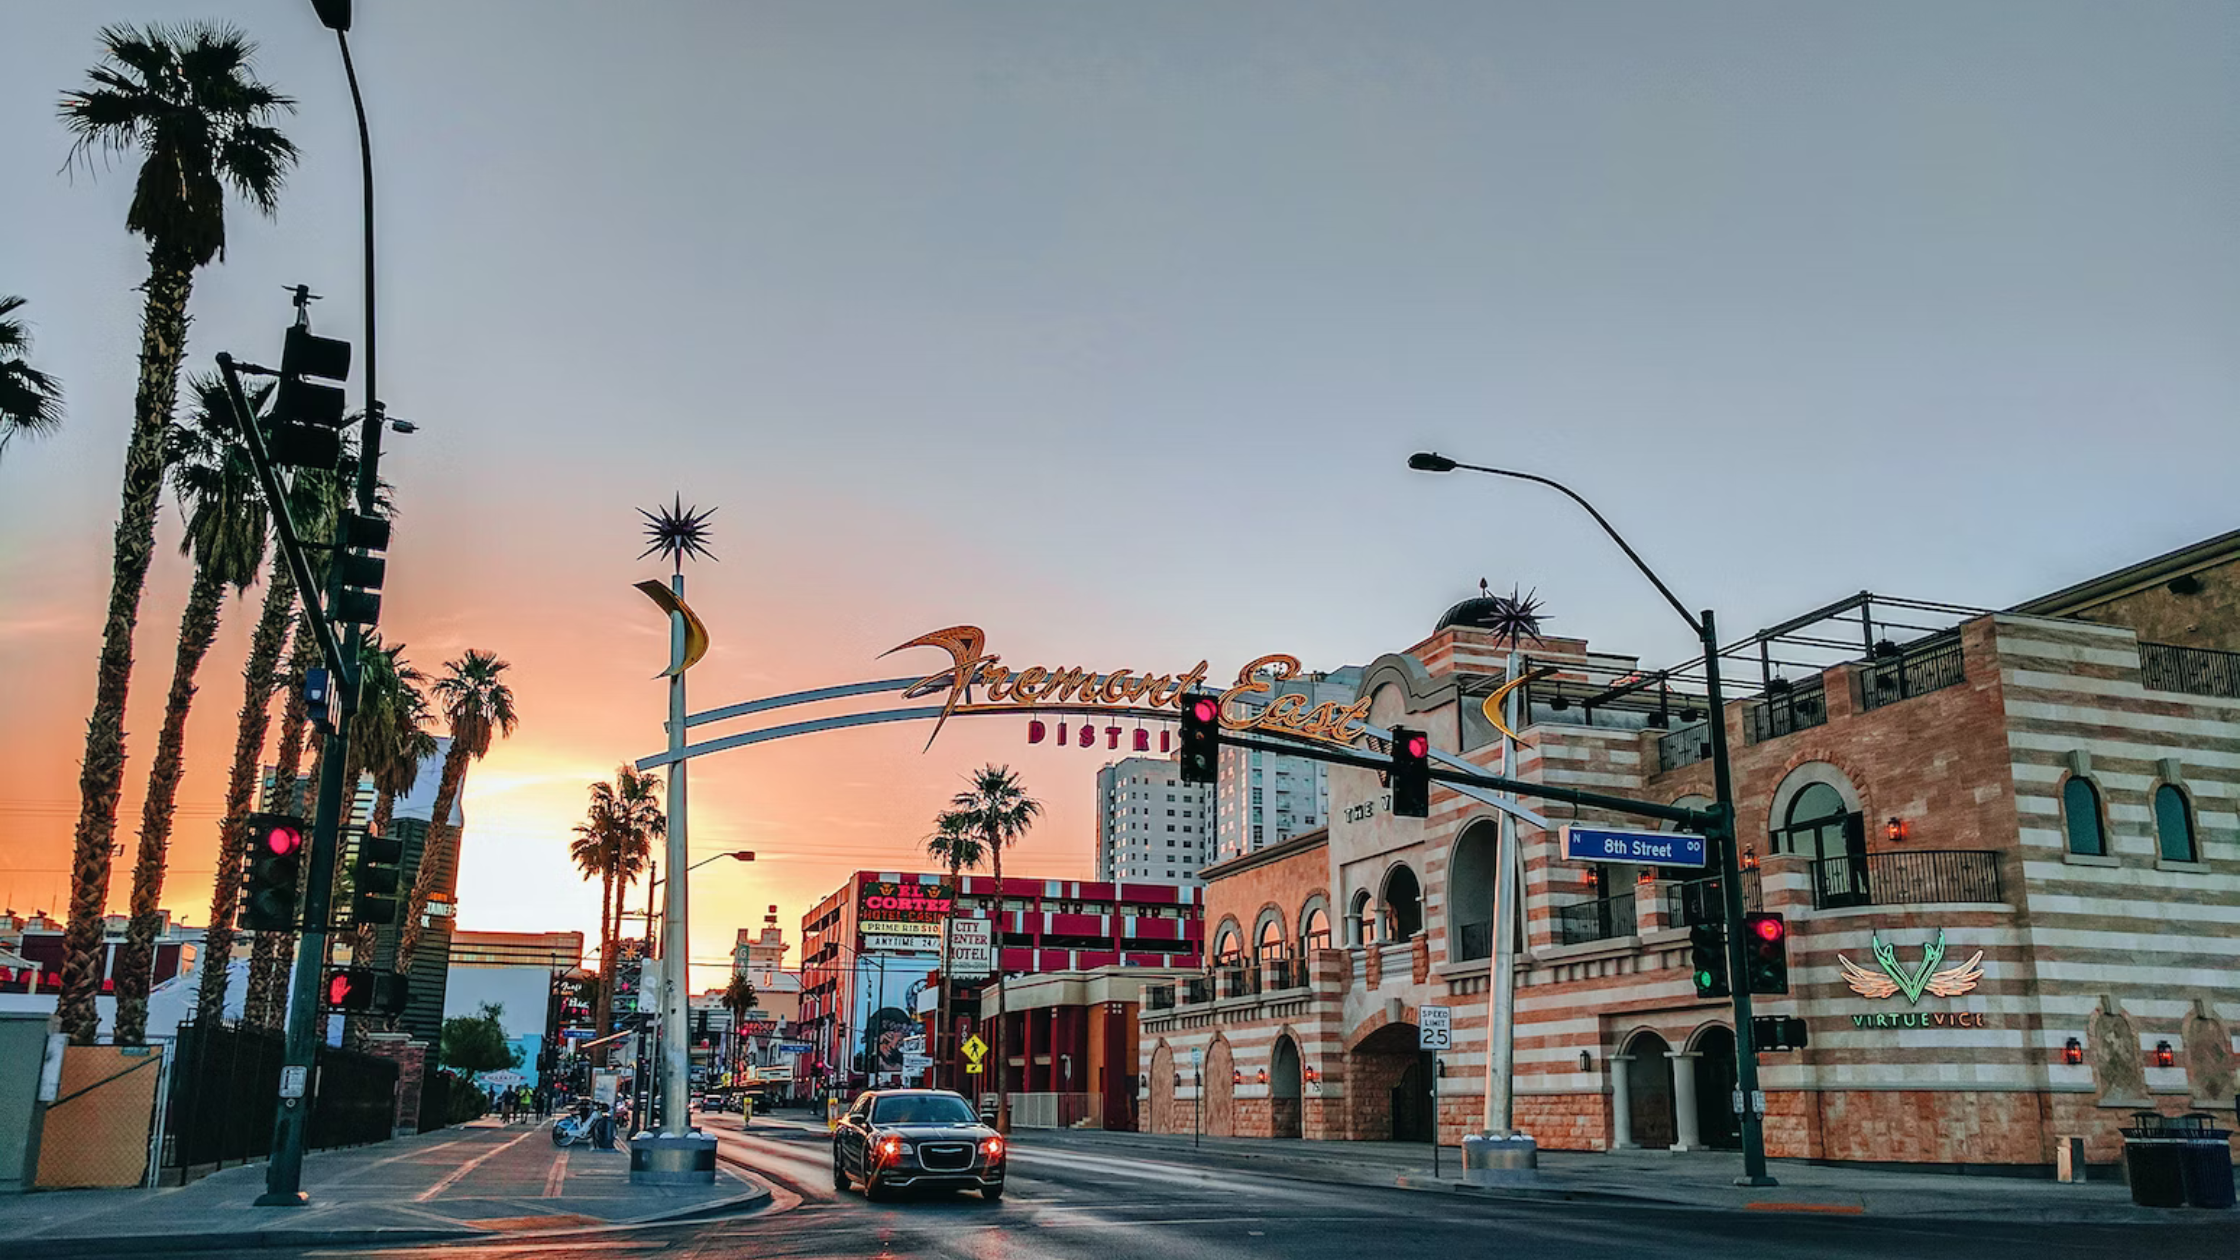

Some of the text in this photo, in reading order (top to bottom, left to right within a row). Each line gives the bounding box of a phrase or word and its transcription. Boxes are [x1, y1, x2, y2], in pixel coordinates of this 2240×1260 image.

[875, 625, 1372, 754] Fremont East
[1028, 720, 1182, 752] DISTRI
[1344, 801, 1374, 824] THE
[1573, 833, 1581, 843] N
[1604, 838, 1627, 855] 8th
[1632, 840, 1672, 858] Street
[898, 885, 924, 897] EL
[866, 896, 950, 911] CORTEZ
[867, 923, 900, 931] PRIME
[955, 922, 980, 932] CITY
[875, 938, 914, 947] ANYTIME
[952, 933, 988, 945] ENTER
[1421, 1010, 1448, 1018] SPEED
[1425, 1019, 1445, 1027] LIMIT
[1423, 1028, 1447, 1044] 25
